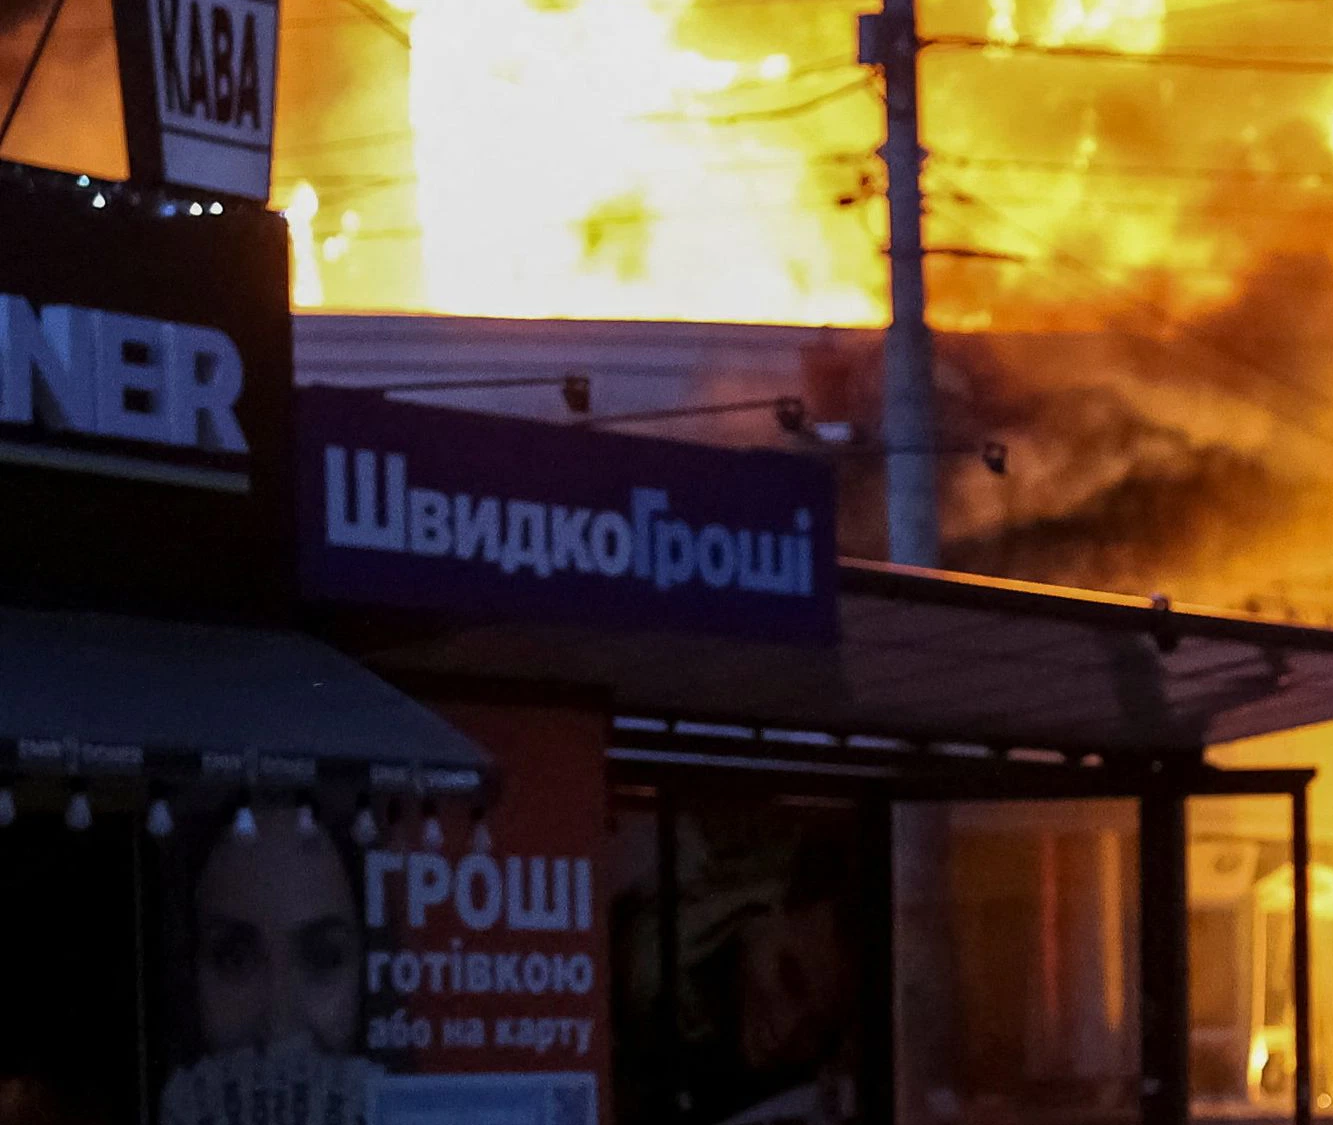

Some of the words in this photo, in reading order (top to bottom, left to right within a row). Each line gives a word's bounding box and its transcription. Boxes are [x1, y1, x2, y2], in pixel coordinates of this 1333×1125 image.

[152, 0, 261, 130] КАВА
[0, 291, 250, 454] NER
[323, 443, 815, 597] ШвидкоГроші
[363, 851, 593, 932] ГРОШІ
[366, 936, 595, 996] готівкою
[366, 1007, 433, 1050] або
[440, 1017, 486, 1048] на
[494, 1016, 595, 1057] карту
